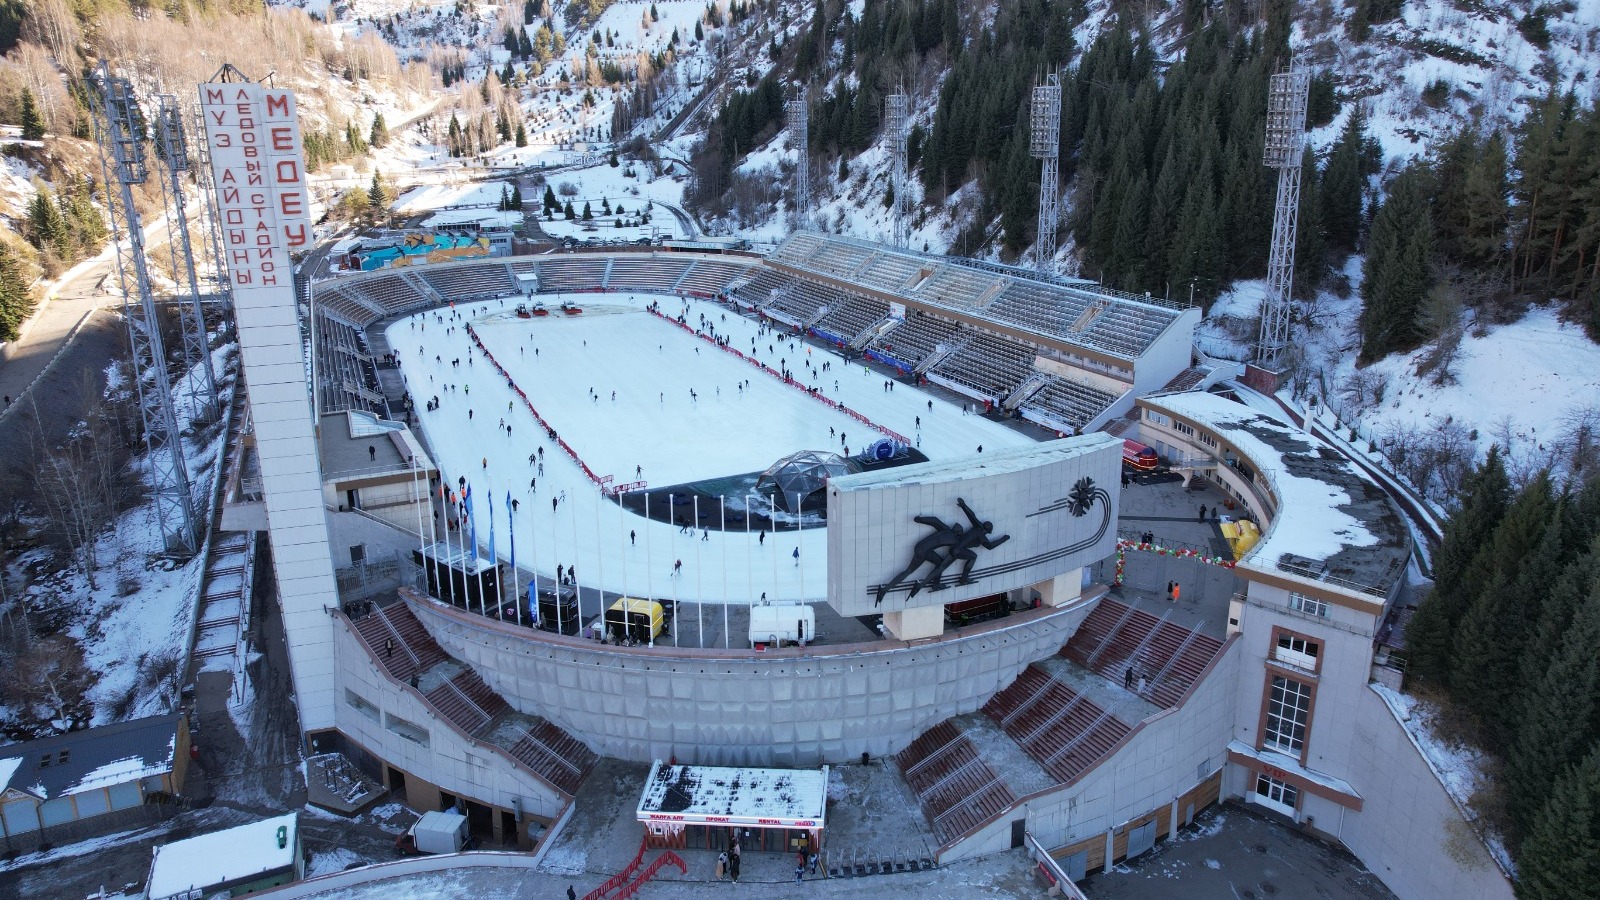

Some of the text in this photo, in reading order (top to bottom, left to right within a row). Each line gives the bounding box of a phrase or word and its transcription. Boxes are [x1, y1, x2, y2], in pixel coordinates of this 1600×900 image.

[222, 167, 252, 285] АЙДЫНЫ
[236, 88, 276, 286] ЛЕДОВЫЙ СТАДИОН
[266, 94, 306, 247] МЕДЕУ
[1264, 765, 1286, 777] VIP
